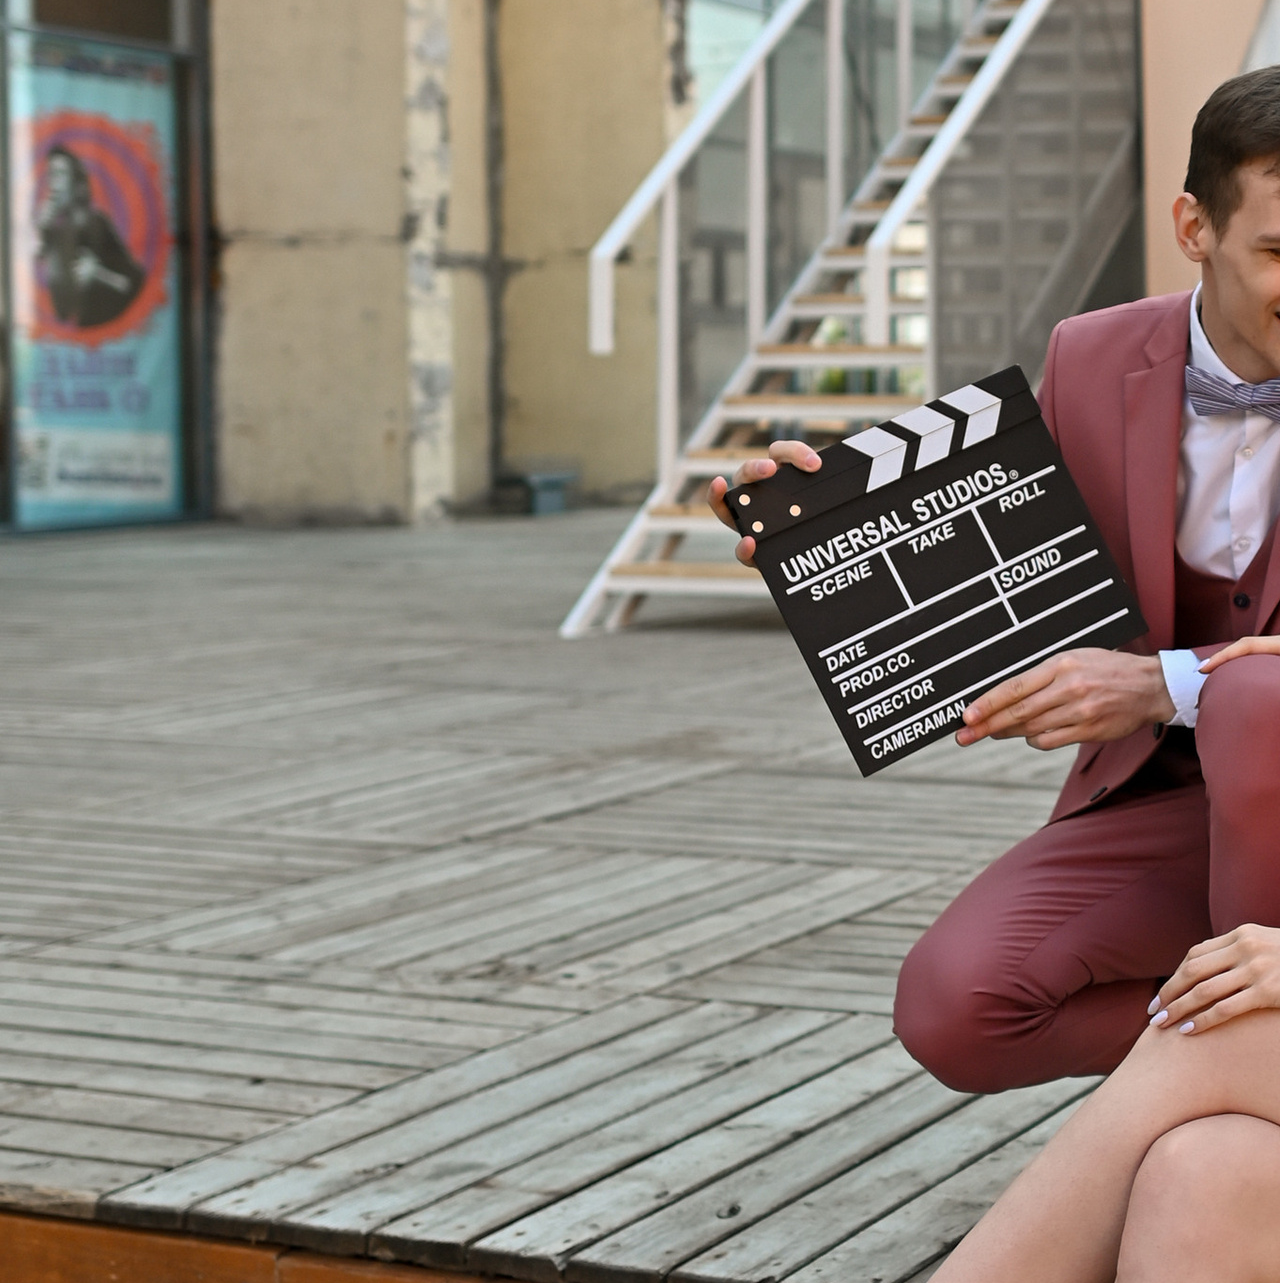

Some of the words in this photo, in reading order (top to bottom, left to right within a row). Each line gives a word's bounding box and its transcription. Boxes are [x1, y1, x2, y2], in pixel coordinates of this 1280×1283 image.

[998, 482, 1046, 513] ROLL
[780, 510, 912, 583] UNIVERSAL
[907, 522, 956, 554] TAKE
[810, 561, 873, 602] SCENE
[1000, 548, 1062, 589] SOUND
[826, 641, 868, 672] DATE
[839, 652, 915, 698] PROD.CO.
[855, 678, 935, 729] DIRECTOR
[870, 700, 967, 759] CAMERAMAN
